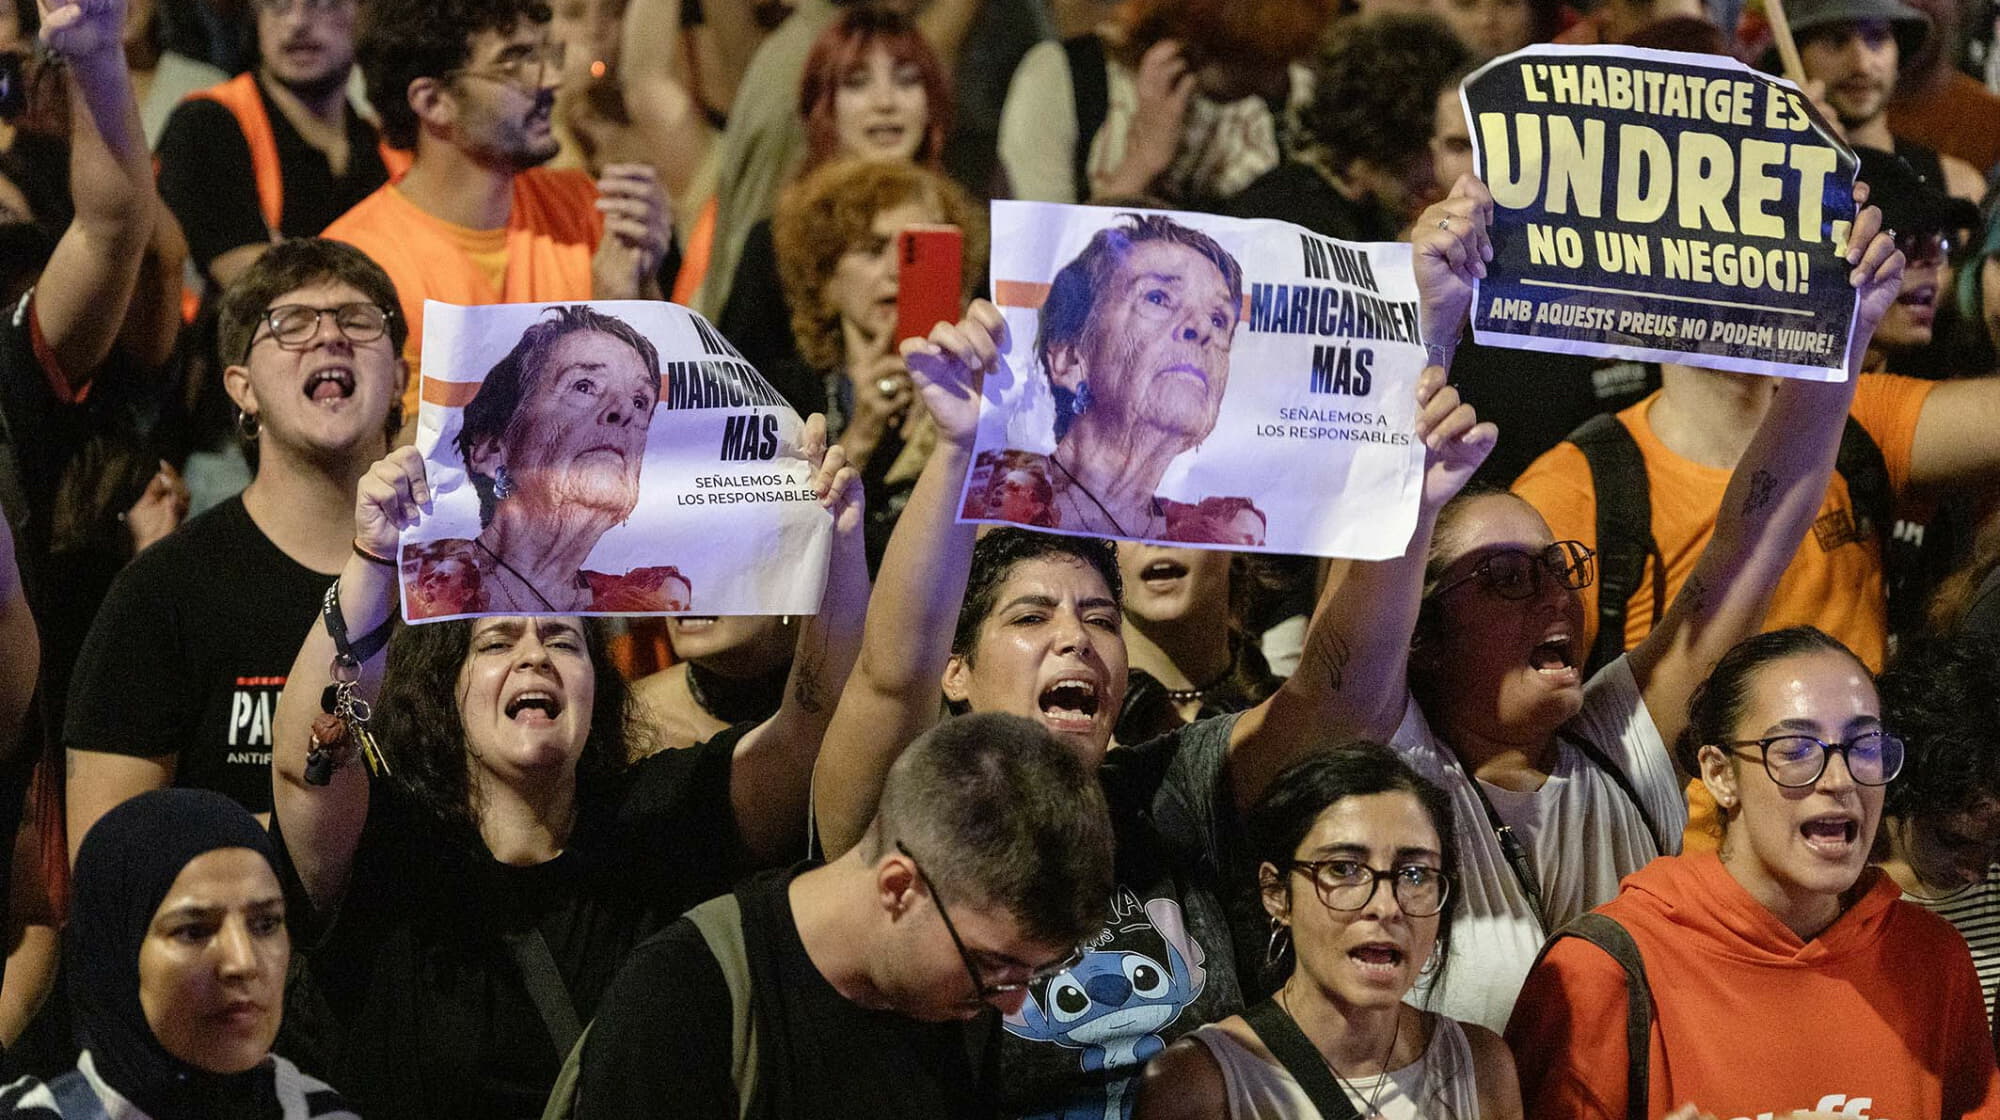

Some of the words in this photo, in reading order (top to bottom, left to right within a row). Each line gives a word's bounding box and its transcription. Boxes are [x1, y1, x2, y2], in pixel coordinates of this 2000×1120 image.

[1520, 63, 1753, 126] L'HABITATGE
[1478, 112, 1605, 218] UN
[1300, 233, 1331, 280] NI
[1326, 241, 1380, 294] UNA
[1526, 223, 1584, 270] NO
[1594, 230, 1651, 277] UN
[1661, 236, 1810, 294] NEGOCI!
[1249, 282, 1422, 346] MARICARMEN
[1489, 297, 1531, 322] AMB
[1535, 302, 1614, 330] AQUESTS
[1617, 311, 1678, 338] PREUS
[1681, 317, 1706, 341] NO
[1709, 320, 1774, 349] PODEM
[1777, 329, 1835, 355] VIURE!
[1310, 340, 1375, 397] MÁS
[720, 408, 779, 462] MÁS
[1256, 424, 1285, 438] LOS
[1289, 425, 1410, 446] RESPONSABLES
[1279, 405, 1373, 425] SEÑALEMOS
[1376, 413, 1388, 427] A
[677, 494, 705, 506] LOS
[708, 489, 818, 505] RESPONSABLES
[695, 474, 782, 489] SEÑALEMOS
[785, 474, 796, 485] A
